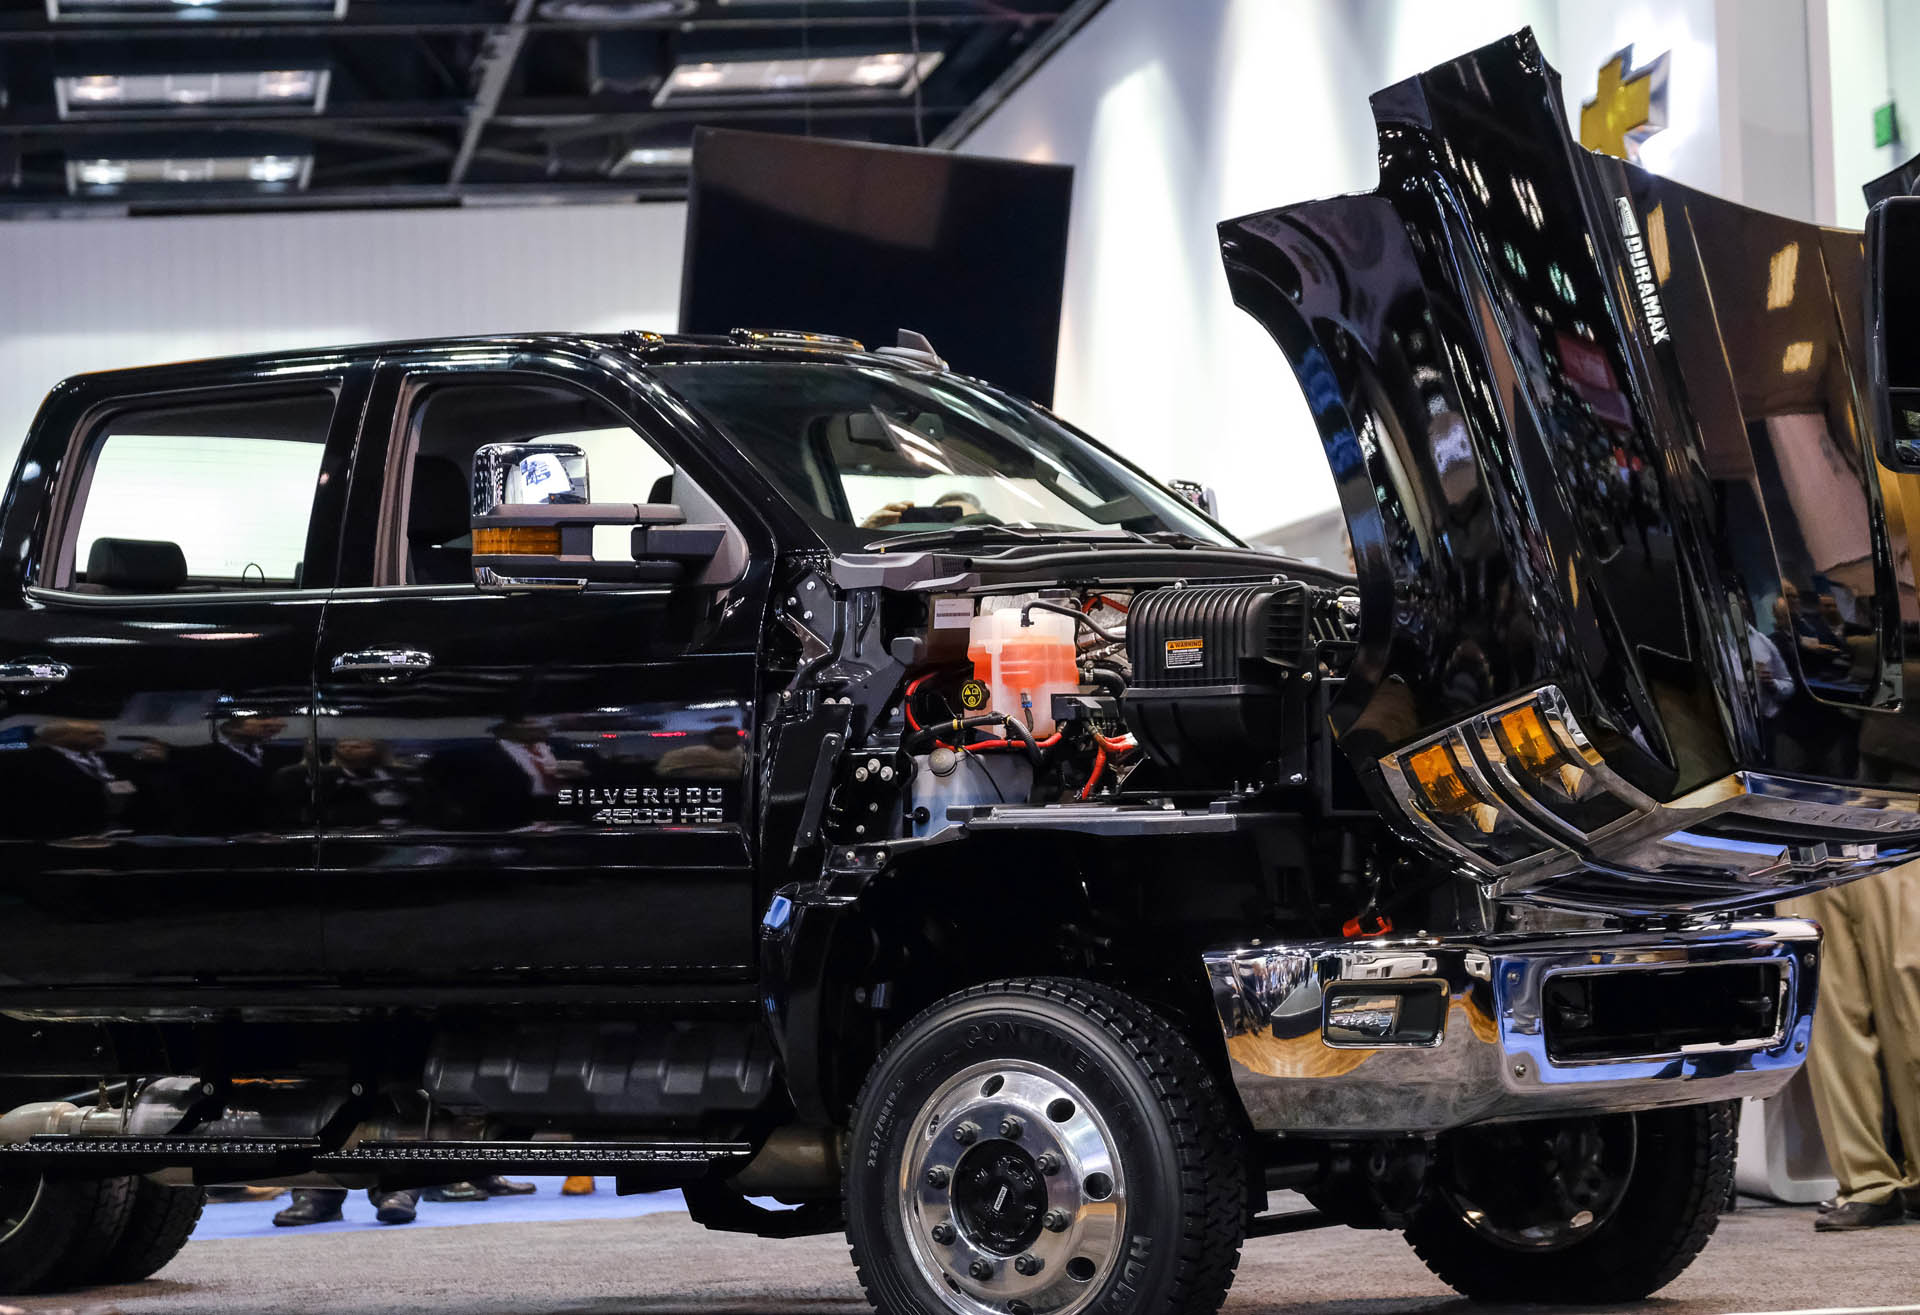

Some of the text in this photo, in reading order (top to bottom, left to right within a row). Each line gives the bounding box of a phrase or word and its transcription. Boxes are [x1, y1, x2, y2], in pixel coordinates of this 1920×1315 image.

[1624, 235, 1671, 345] DURAMAX
[558, 787, 723, 805] SILVERADO
[592, 807, 723, 824] 4500 HD
